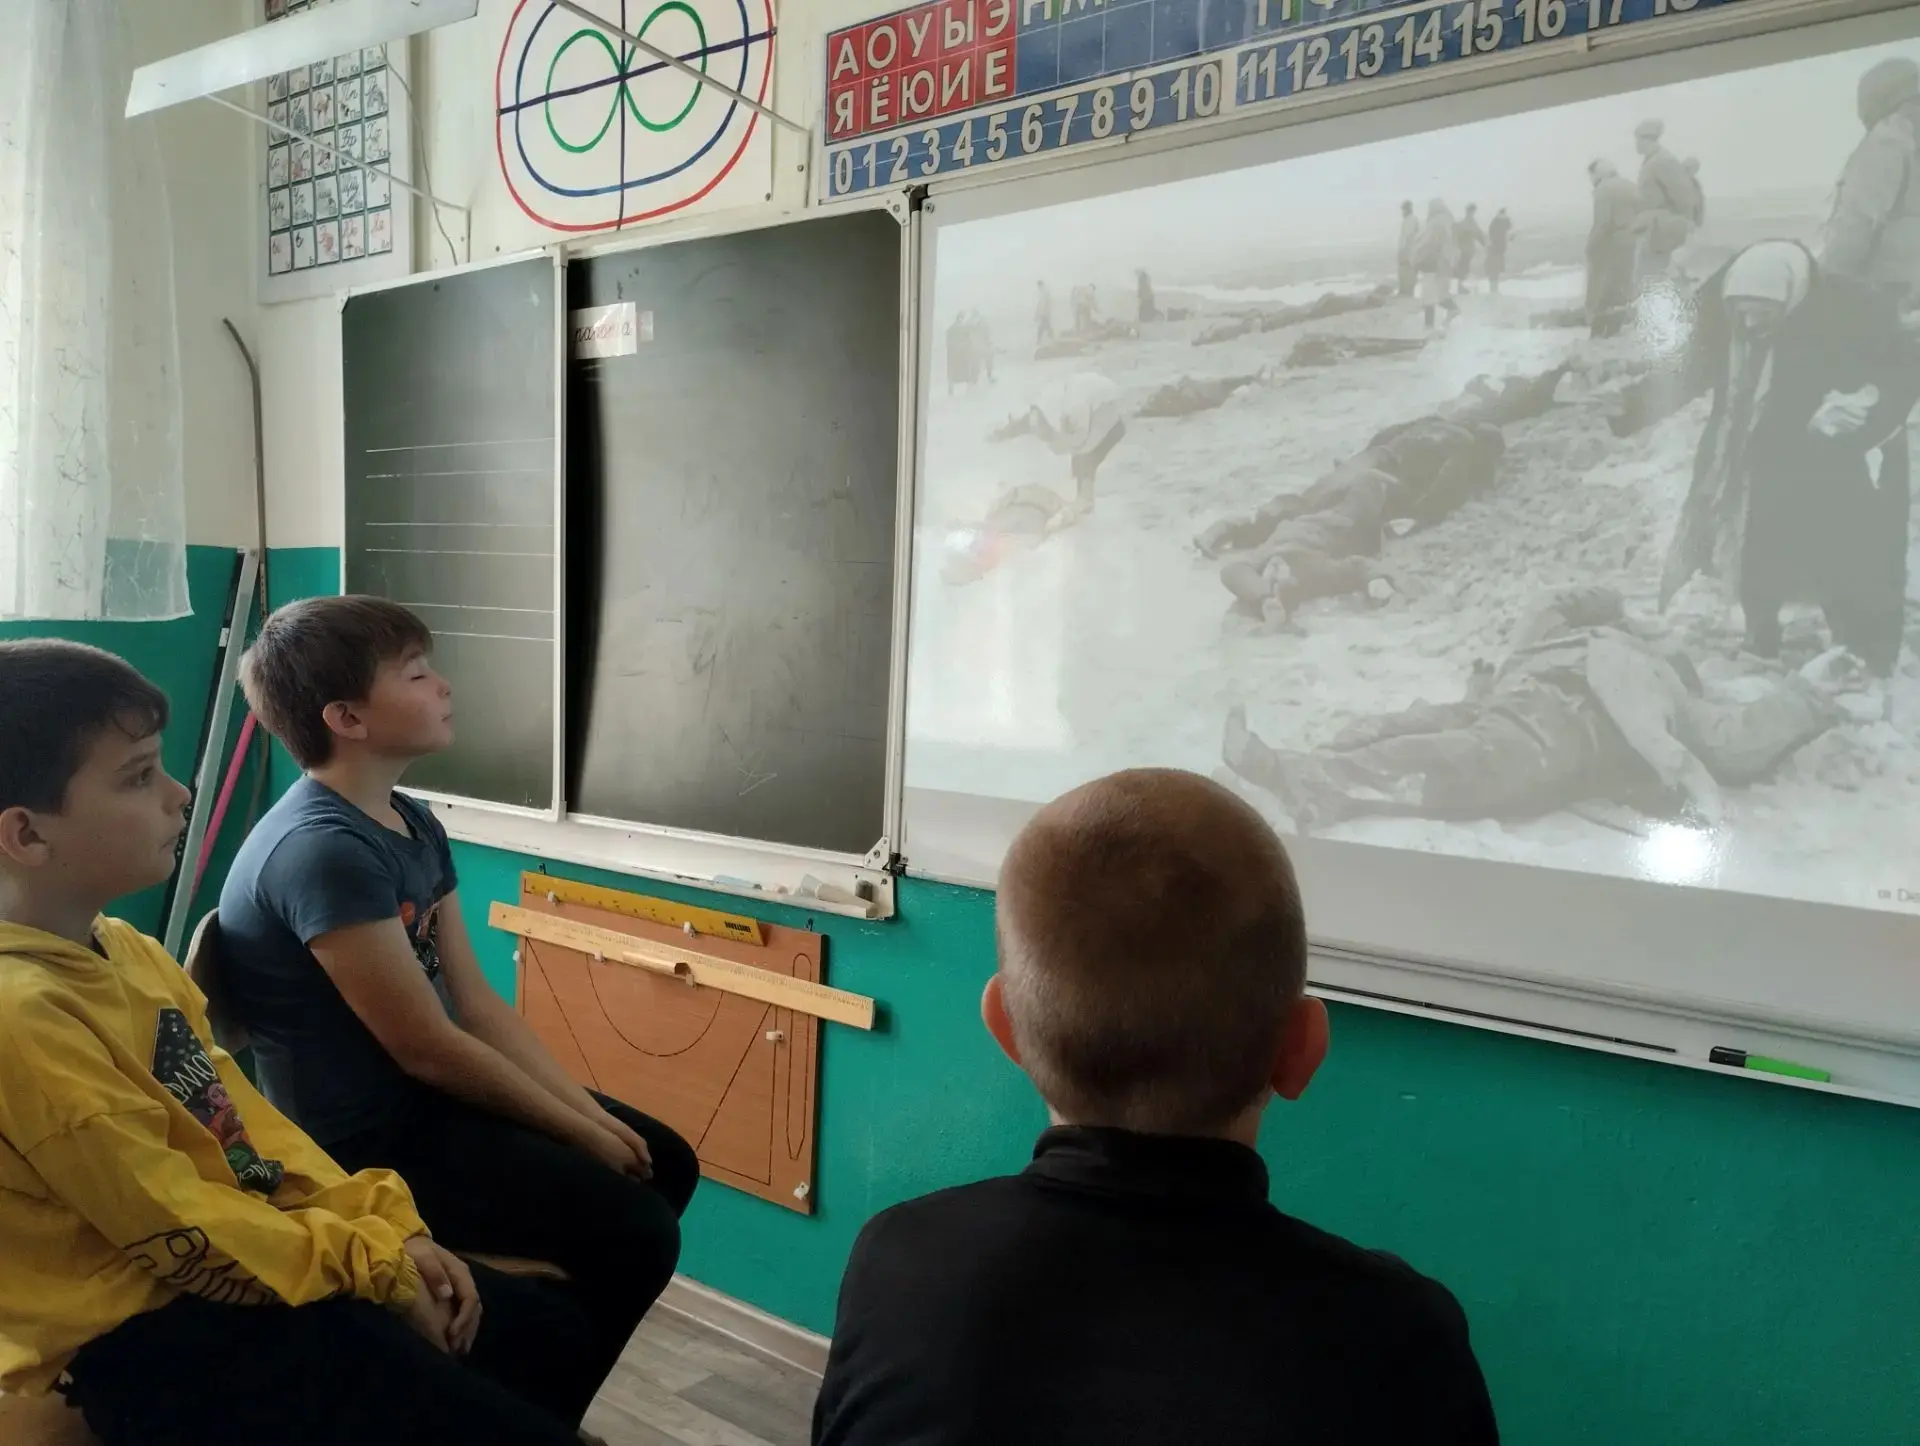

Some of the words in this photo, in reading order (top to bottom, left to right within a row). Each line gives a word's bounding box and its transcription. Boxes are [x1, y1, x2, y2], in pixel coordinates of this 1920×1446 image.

[1240, 48, 1277, 101] 11
[1287, 37, 1331, 92] 12
[1340, 24, 1385, 80] 13
[1394, 10, 1443, 68] 14
[1453, 1, 1504, 56] 15
[1515, 0, 1567, 43] 16
[835, 151, 853, 195] 0
[863, 142, 877, 187] 1
[889, 136, 909, 183] 2
[921, 128, 941, 175] 3
[952, 120, 974, 166] 4
[986, 112, 1008, 161] 5
[1020, 104, 1043, 154] 6
[1056, 95, 1079, 147] 7
[1091, 87, 1115, 138] 8
[1130, 78, 1155, 130] 9
[1169, 63, 1220, 121] 10
